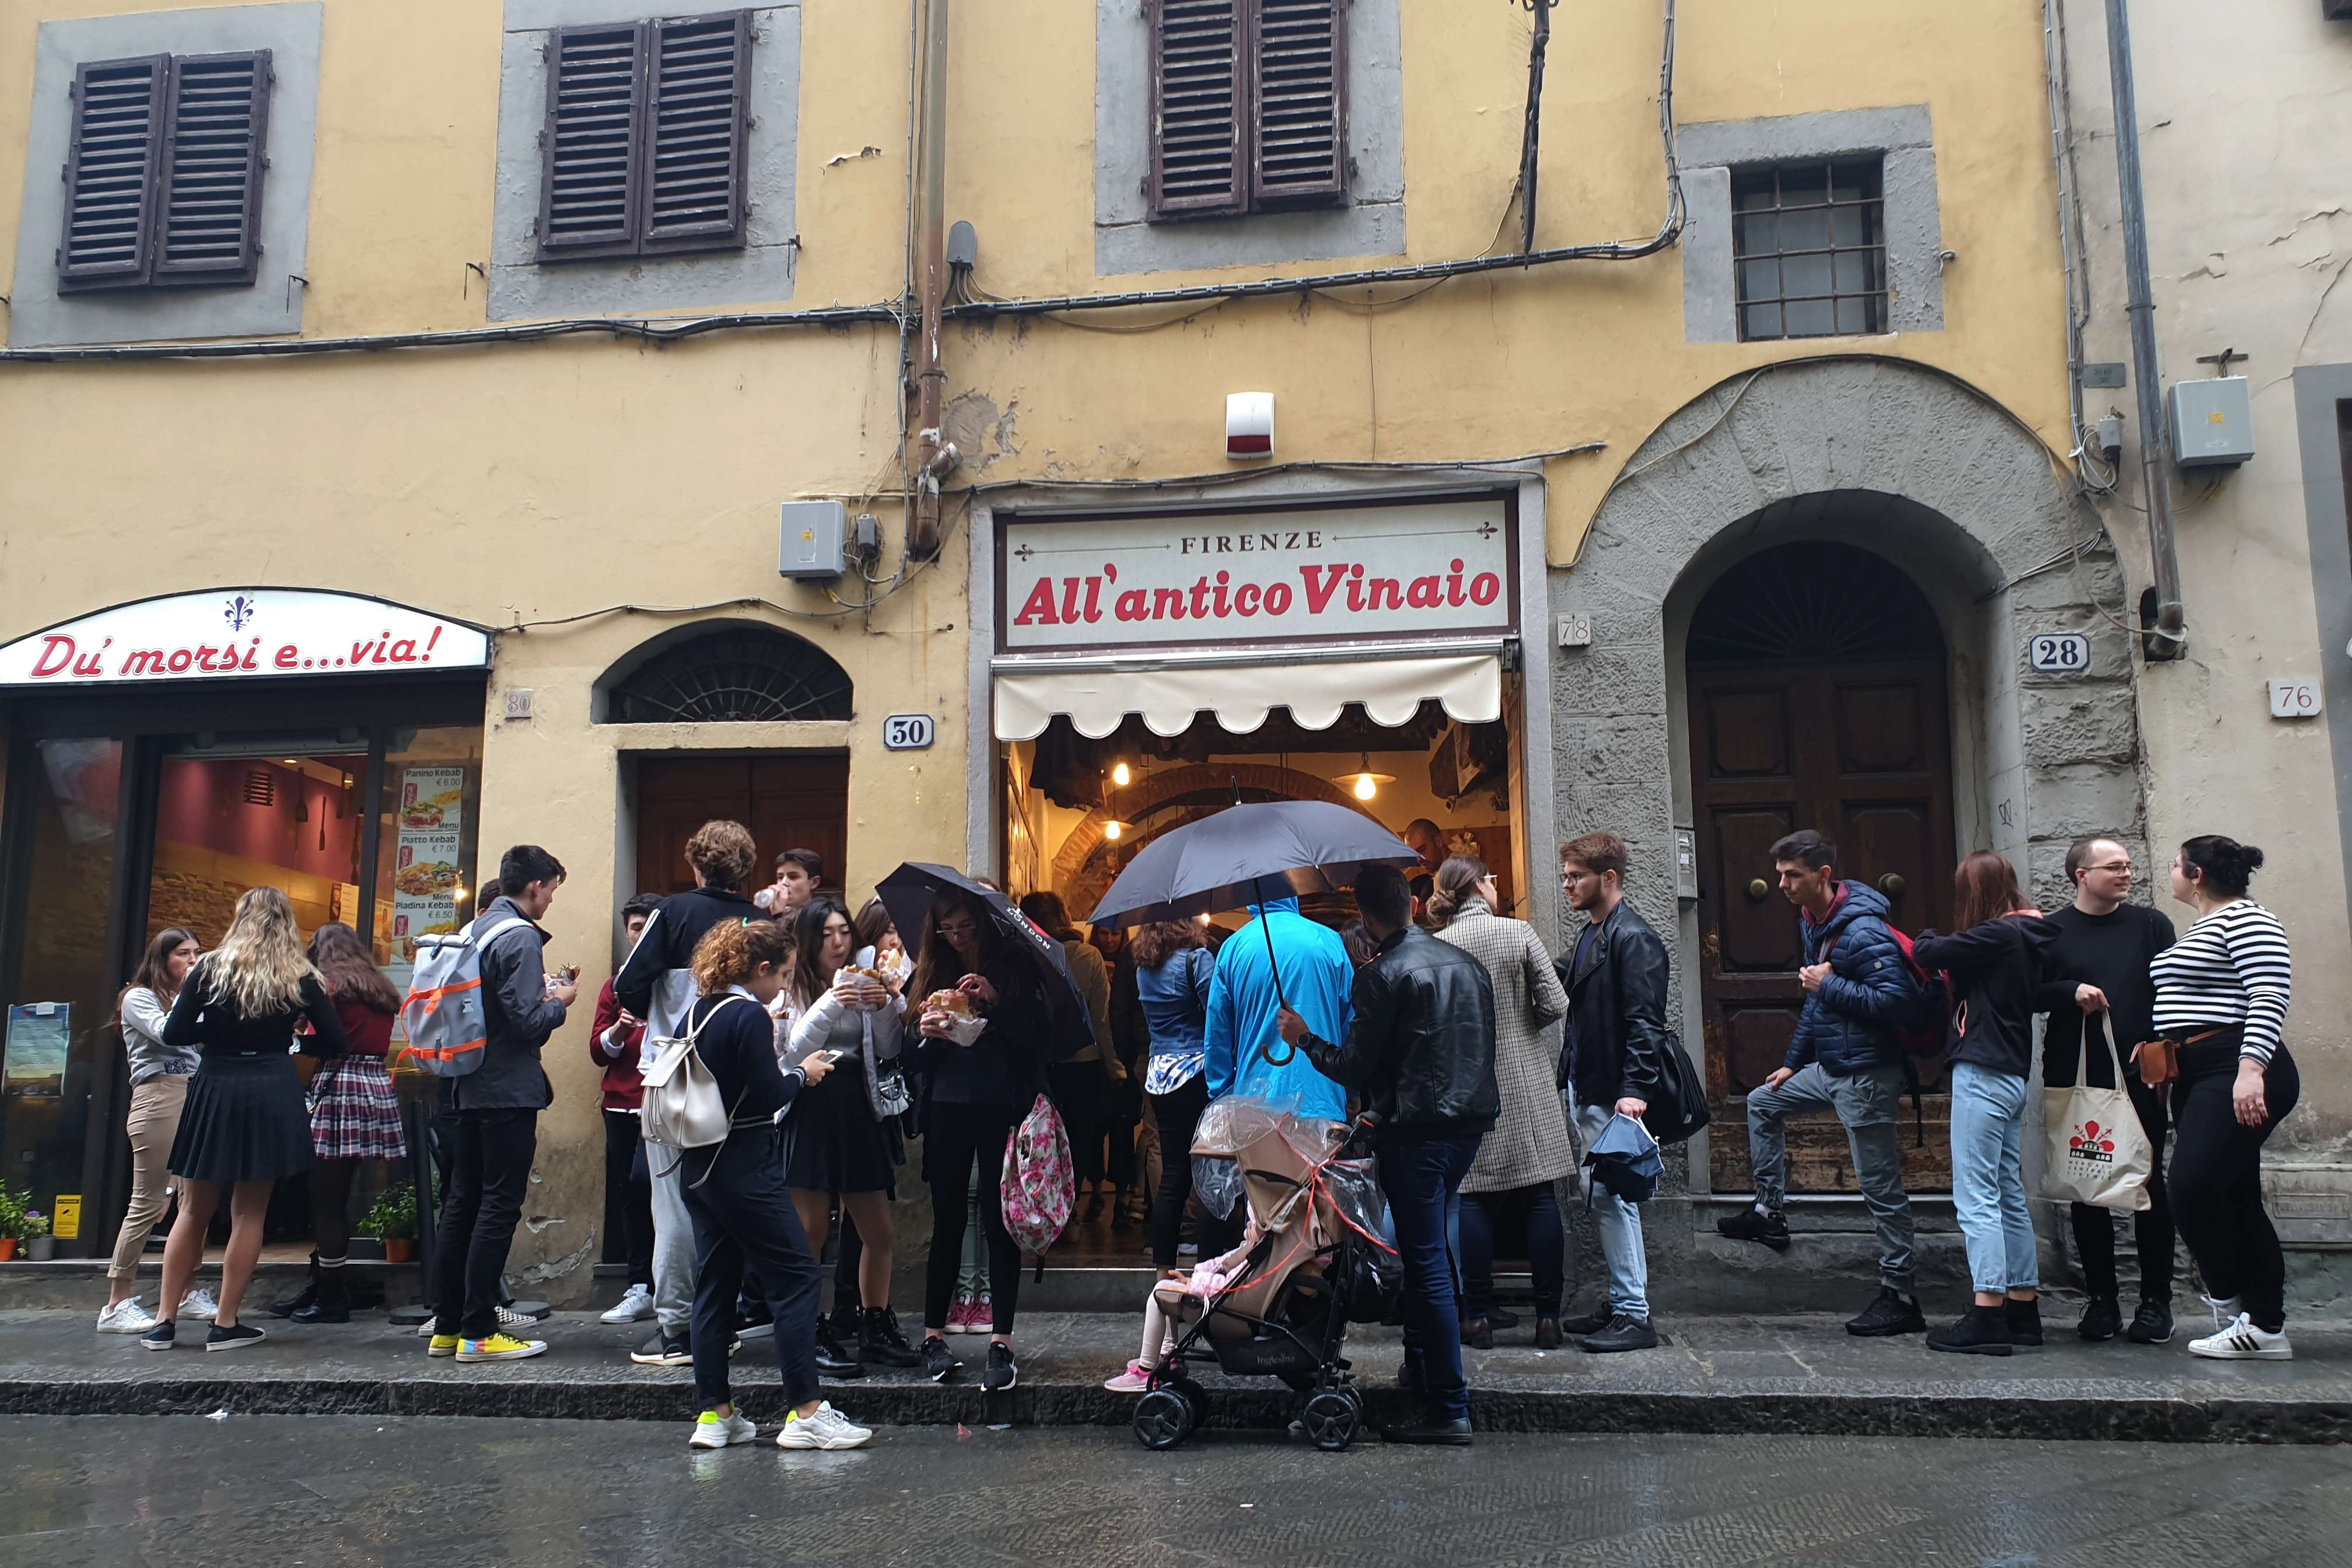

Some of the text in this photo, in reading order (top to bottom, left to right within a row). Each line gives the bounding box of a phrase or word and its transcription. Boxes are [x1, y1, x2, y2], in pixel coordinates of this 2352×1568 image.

[1180, 531, 1322, 555] FIRENZE
[1013, 558, 1500, 625] All'antico Vinaio
[1561, 620, 1588, 639] 78
[30, 634, 113, 678] Du'
[118, 636, 262, 676] morsi
[2039, 639, 2078, 665] 28
[508, 695, 531, 713] 80
[2279, 686, 2312, 708] 76
[892, 720, 924, 744] 30
[1006, 907, 1051, 950] LONDON
